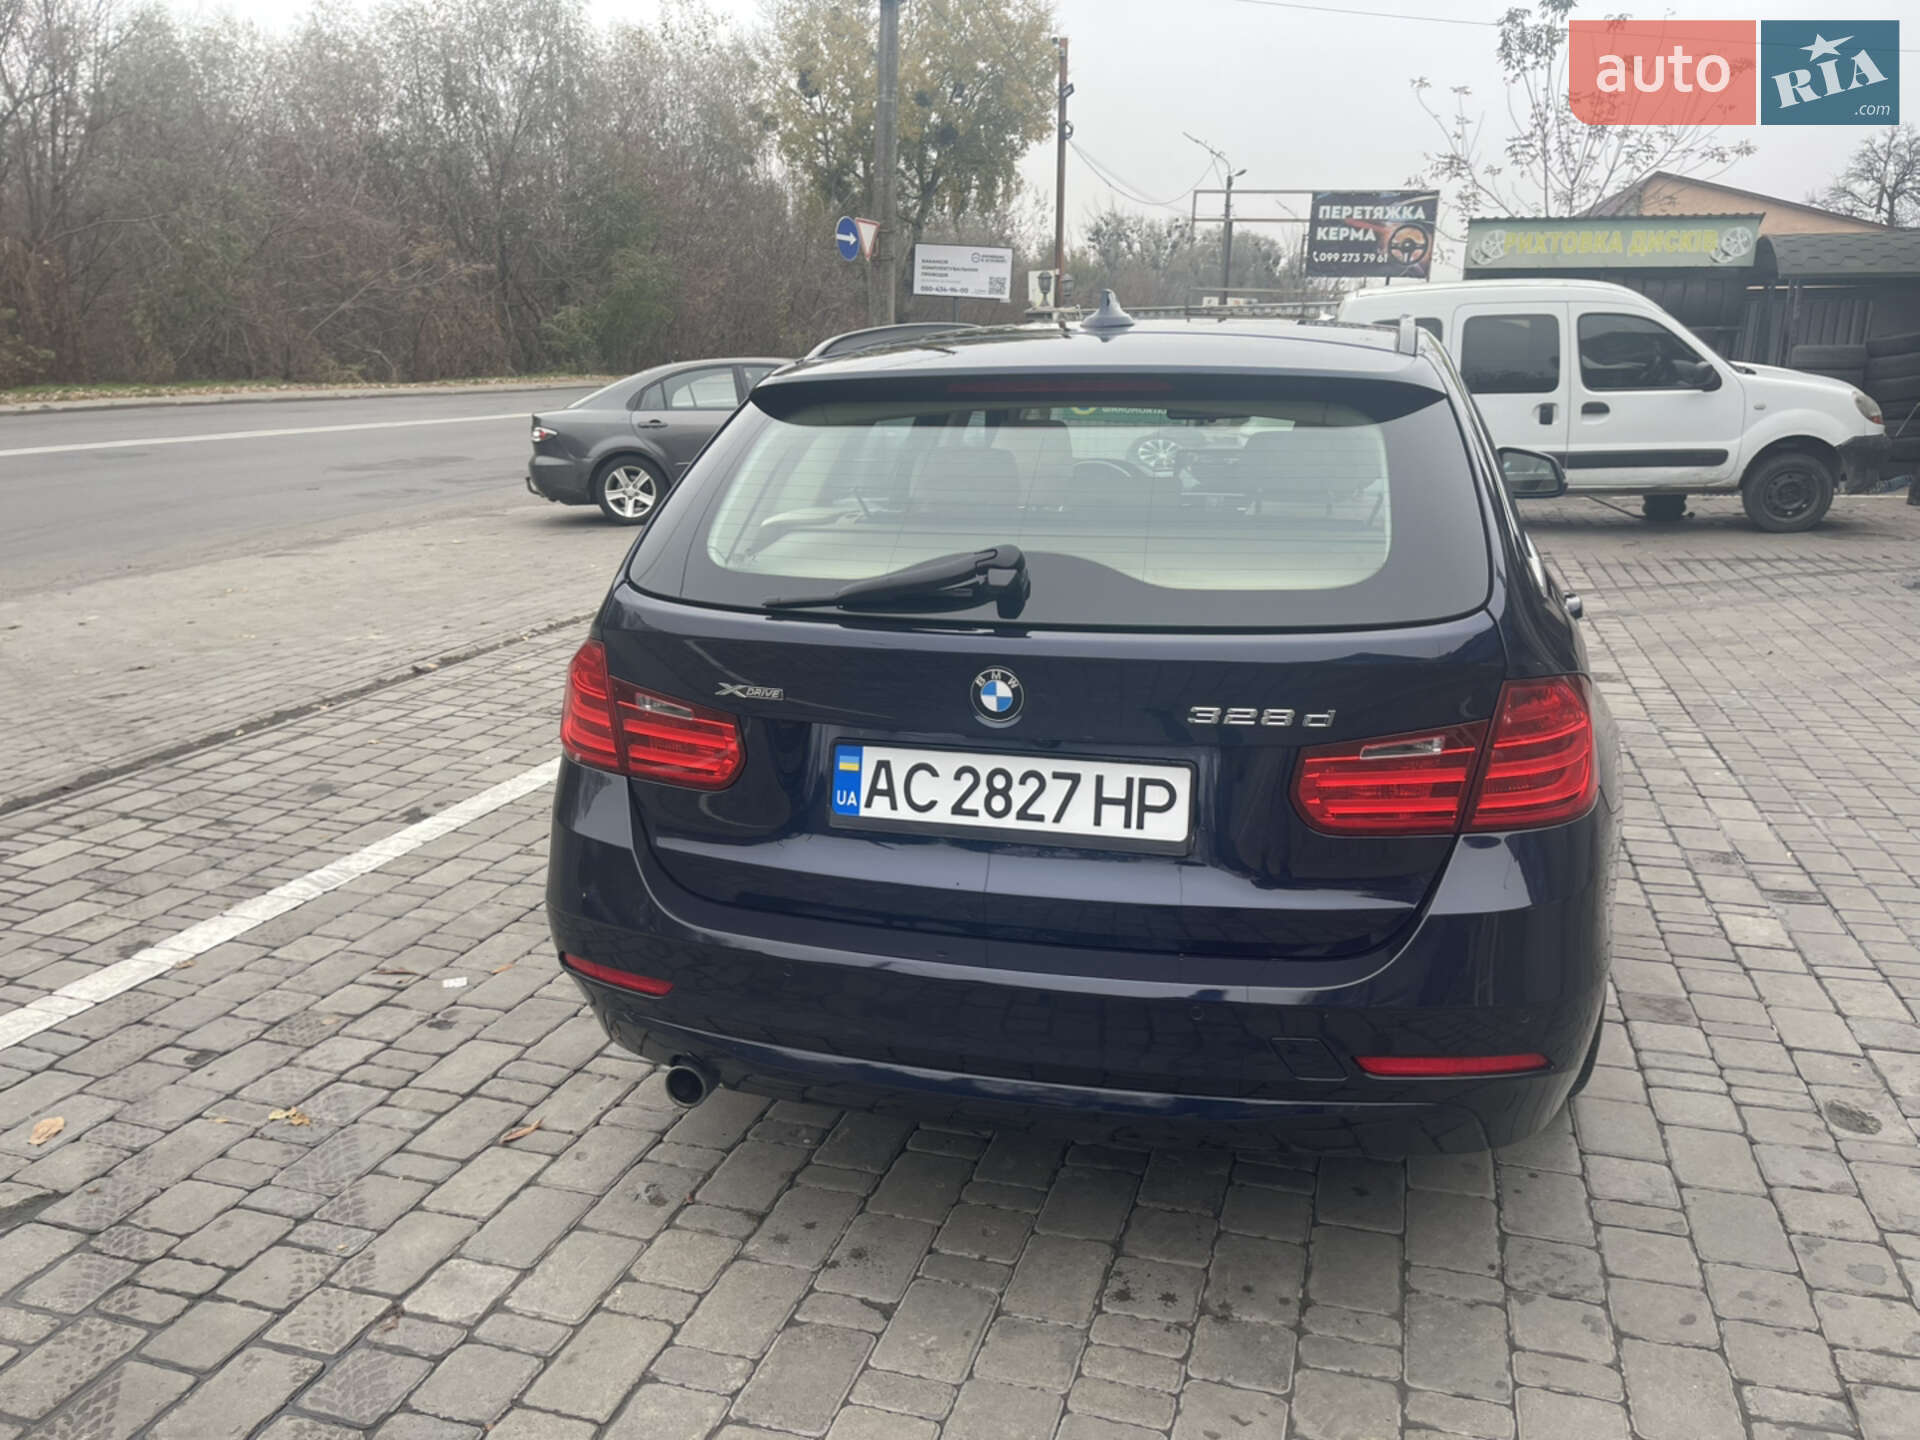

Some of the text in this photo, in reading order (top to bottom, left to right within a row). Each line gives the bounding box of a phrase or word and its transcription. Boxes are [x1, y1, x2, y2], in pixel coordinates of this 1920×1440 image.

[1318, 205, 1426, 220] ПЕРЕТЯЖКА
[1316, 226, 1377, 241] КЕРМА
[1503, 229, 1719, 256] РИХТОВКА ДИСКІВ
[1319, 252, 1340, 262] 099
[1341, 252, 1360, 263] 273
[1362, 253, 1375, 263] 79
[837, 790, 858, 807] UA
[864, 759, 1177, 830] AC 2827 HP
